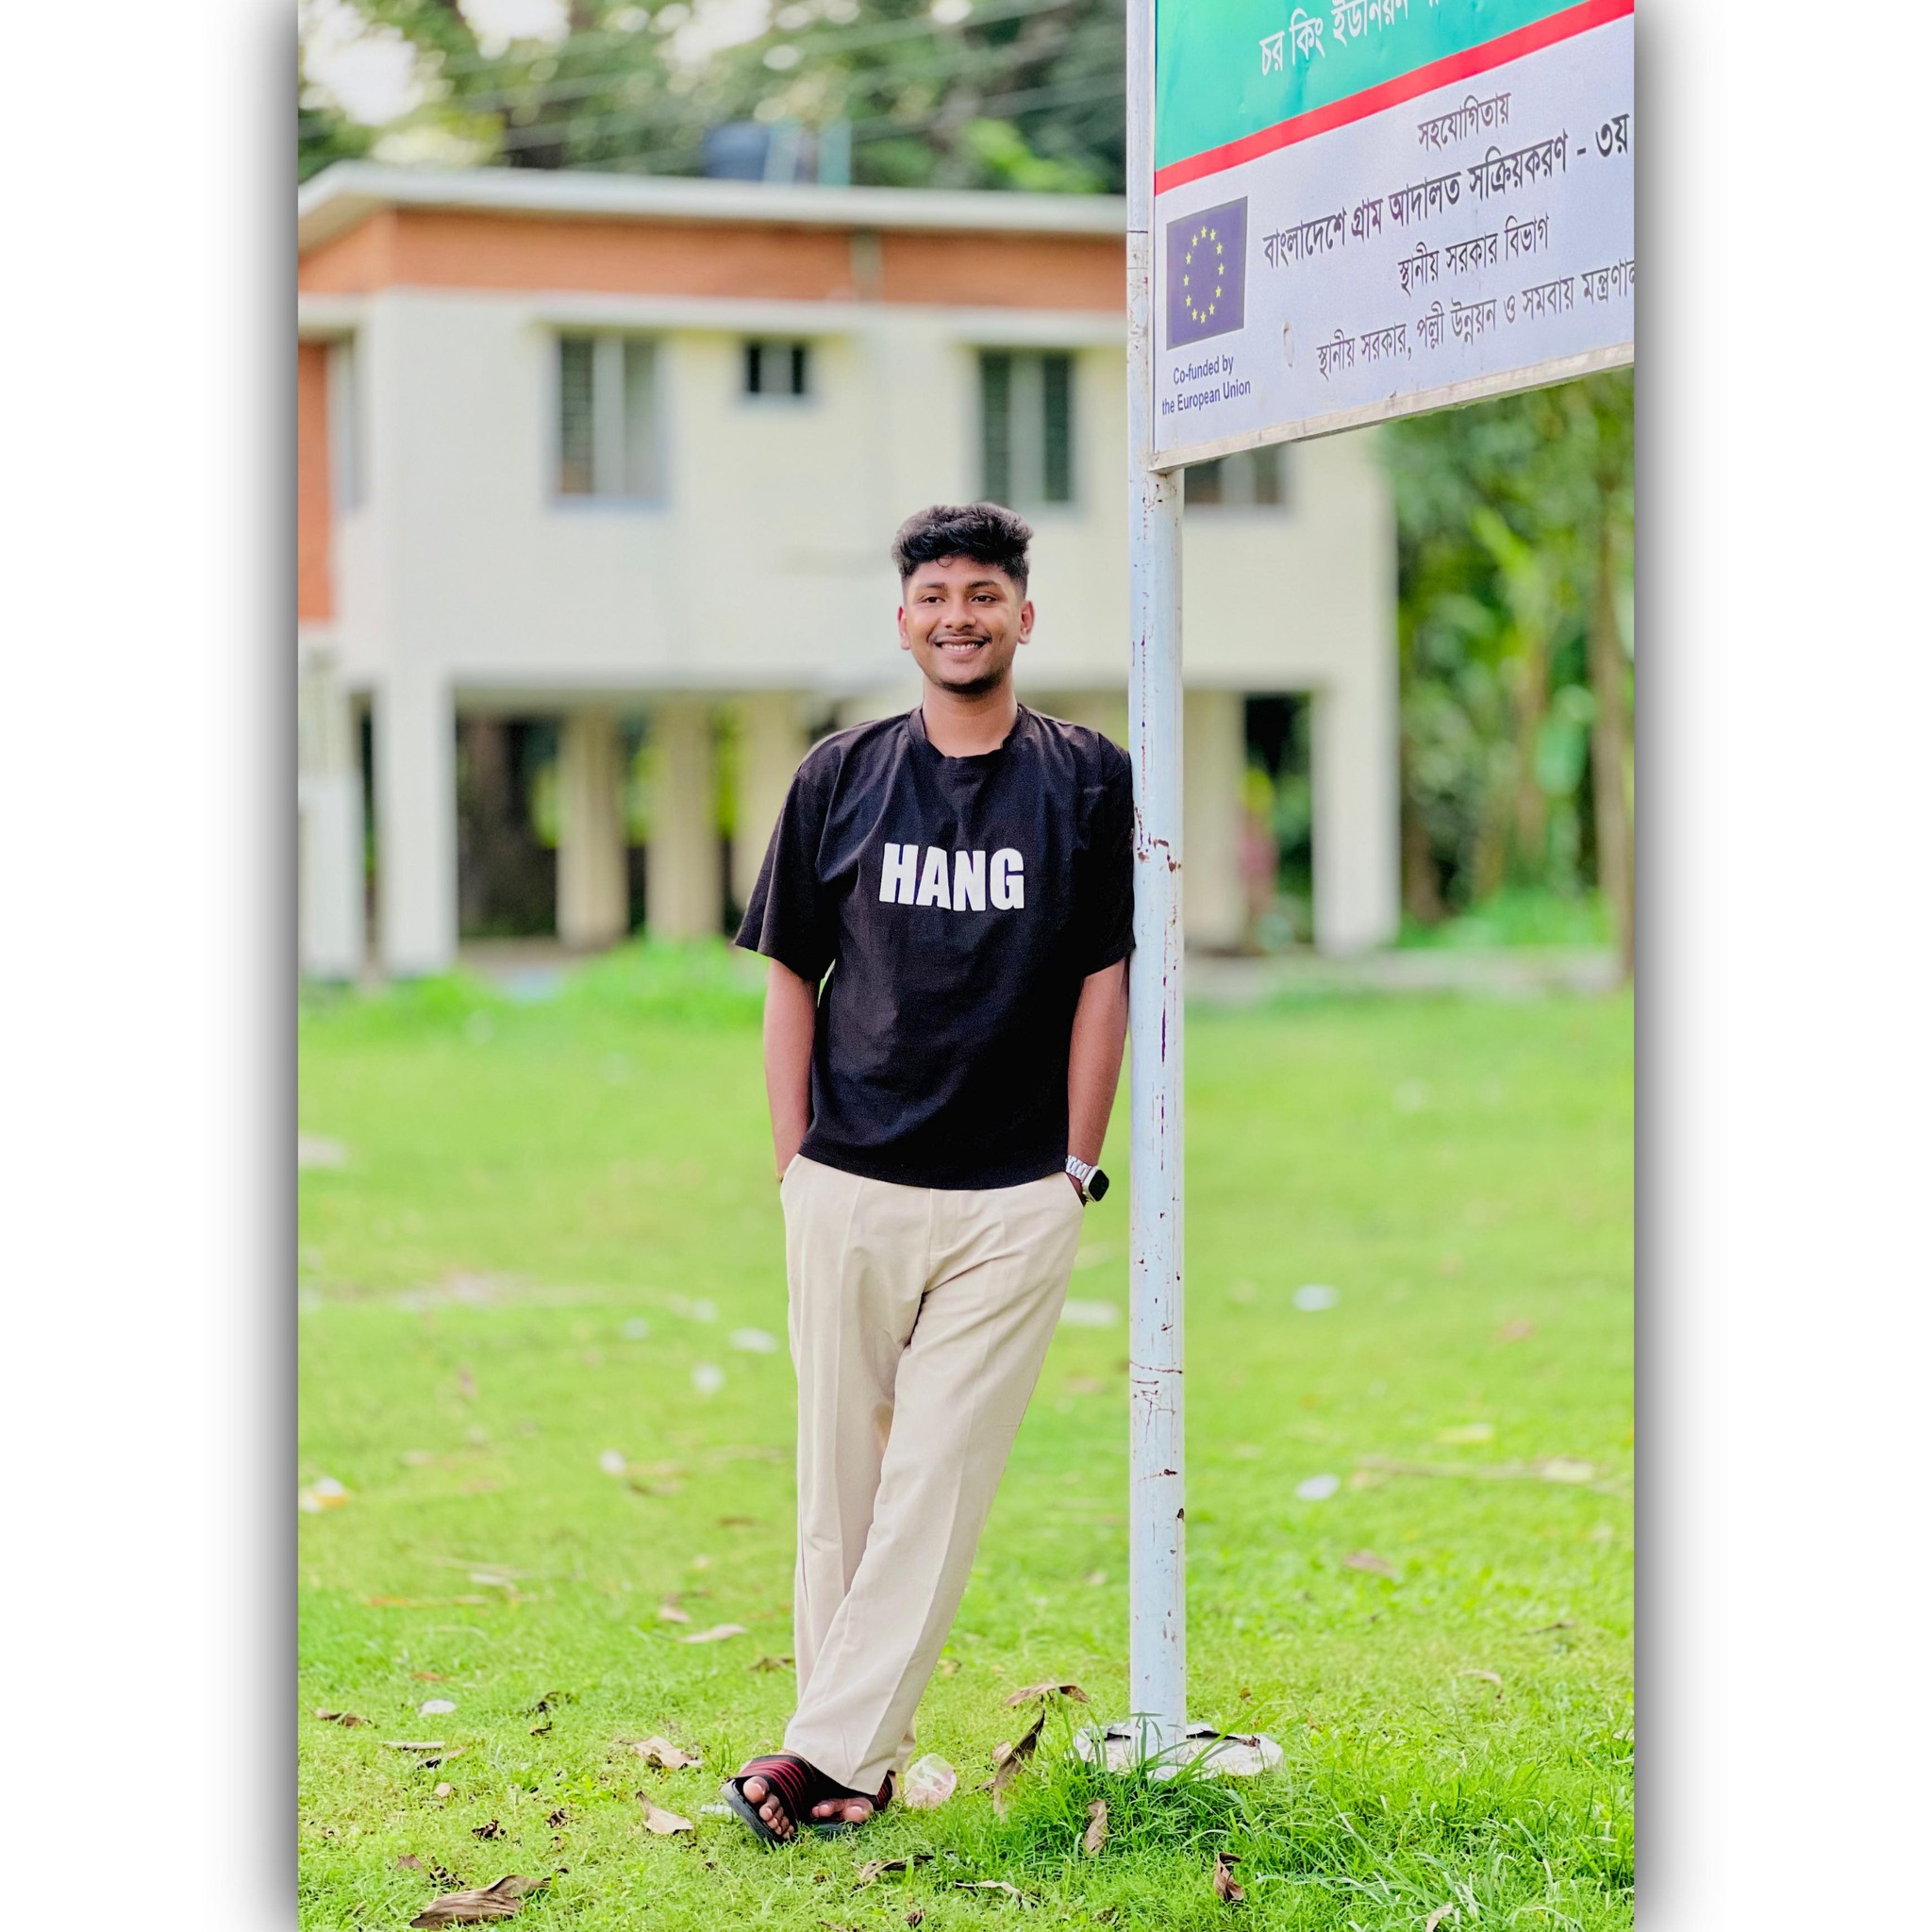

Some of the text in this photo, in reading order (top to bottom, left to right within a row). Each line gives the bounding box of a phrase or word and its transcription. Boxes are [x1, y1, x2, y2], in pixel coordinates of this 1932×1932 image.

[1258, 30, 1286, 76] চর
[1289, 8, 1325, 66] কিং
[1417, 92, 1511, 151] সহযোগিতায়
[1262, 206, 1347, 269] বাংলাদেশে
[1351, 197, 1384, 243] গ্রাম
[1388, 172, 1462, 227] আদালত
[1467, 128, 1569, 199] সক্রিয়করণ
[1595, 113, 1630, 158] ৩য়
[1397, 211, 1550, 296] স্থানীয় সরকার বিভাগ
[1317, 328, 1356, 381] স্থানীয়
[1360, 322, 1412, 362] সরকার,
[1417, 300, 1445, 350] পল্লী
[1450, 297, 1497, 346] উন্নয়ন
[1503, 294, 1516, 324] ও
[1521, 275, 1574, 320] সমবায়
[1161, 379, 1251, 415] the European Union
[1173, 354, 1234, 385] Co-funded by
[879, 842, 1024, 912] HANG
